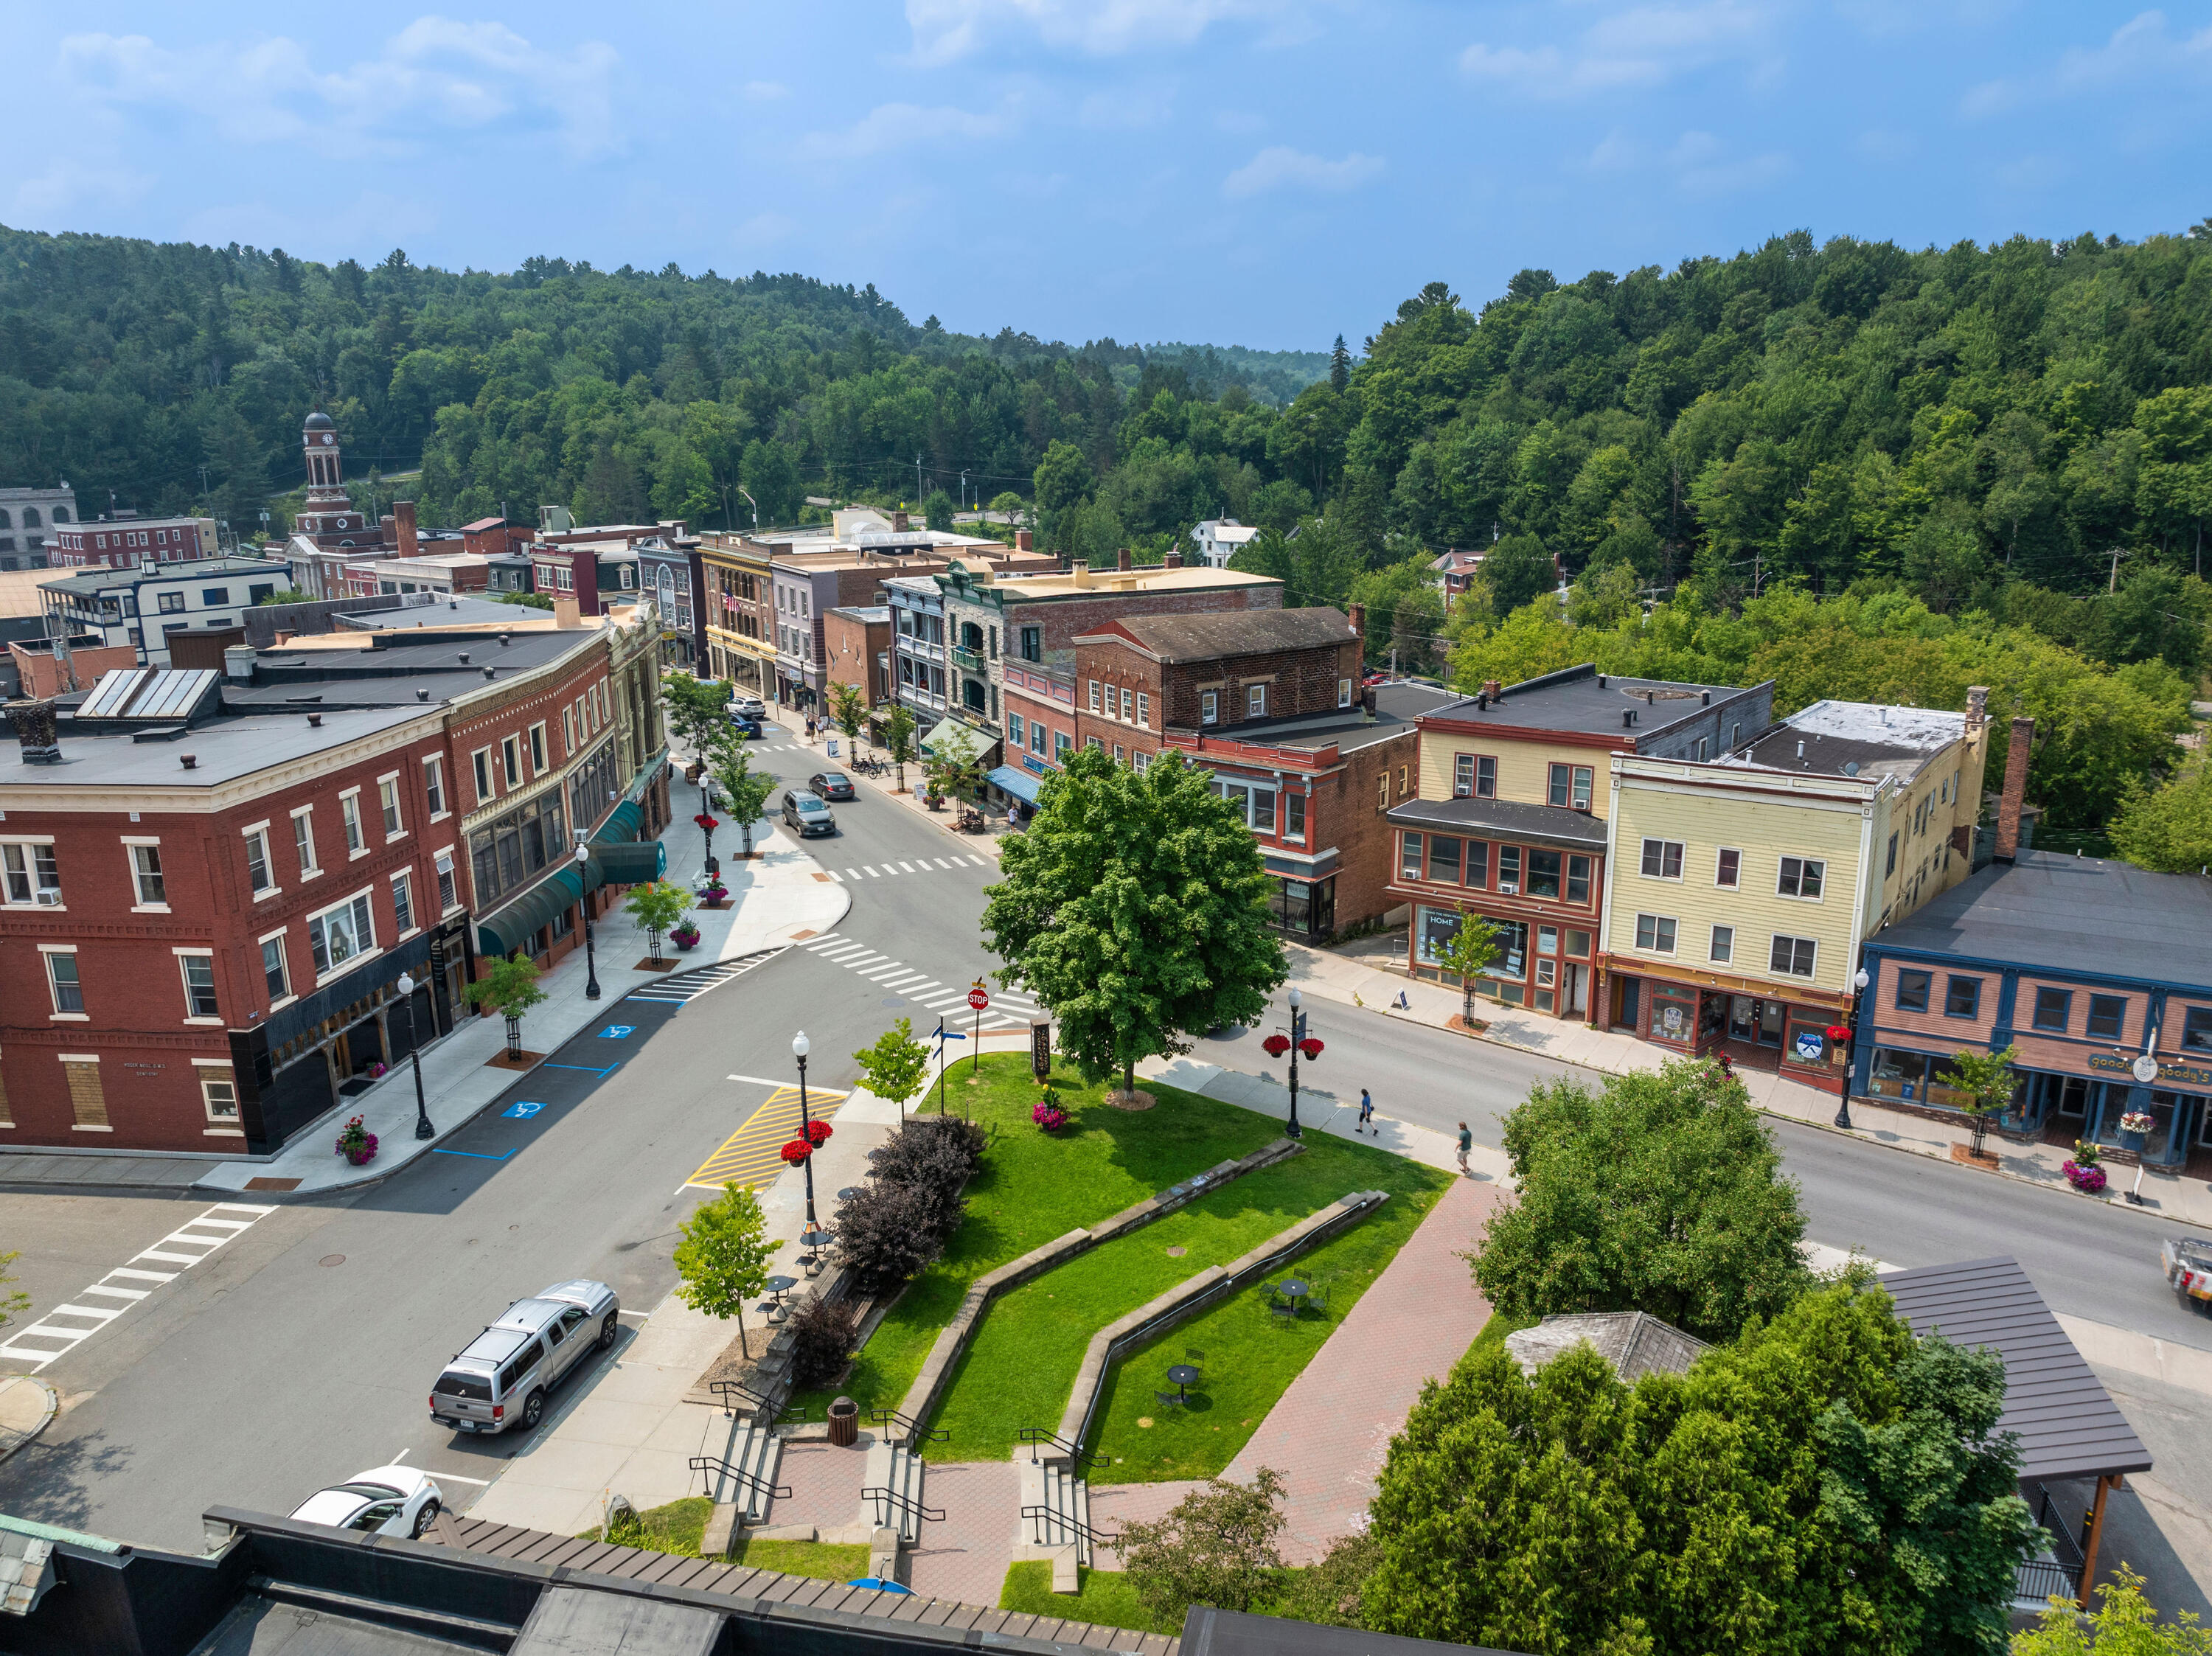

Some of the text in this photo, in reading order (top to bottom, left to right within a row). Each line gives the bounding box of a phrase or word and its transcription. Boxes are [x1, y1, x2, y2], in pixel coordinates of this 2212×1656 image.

[1430, 916, 1453, 927] HOME
[969, 994, 988, 1005] STOP
[2091, 1057, 2210, 1083] goody goody's
